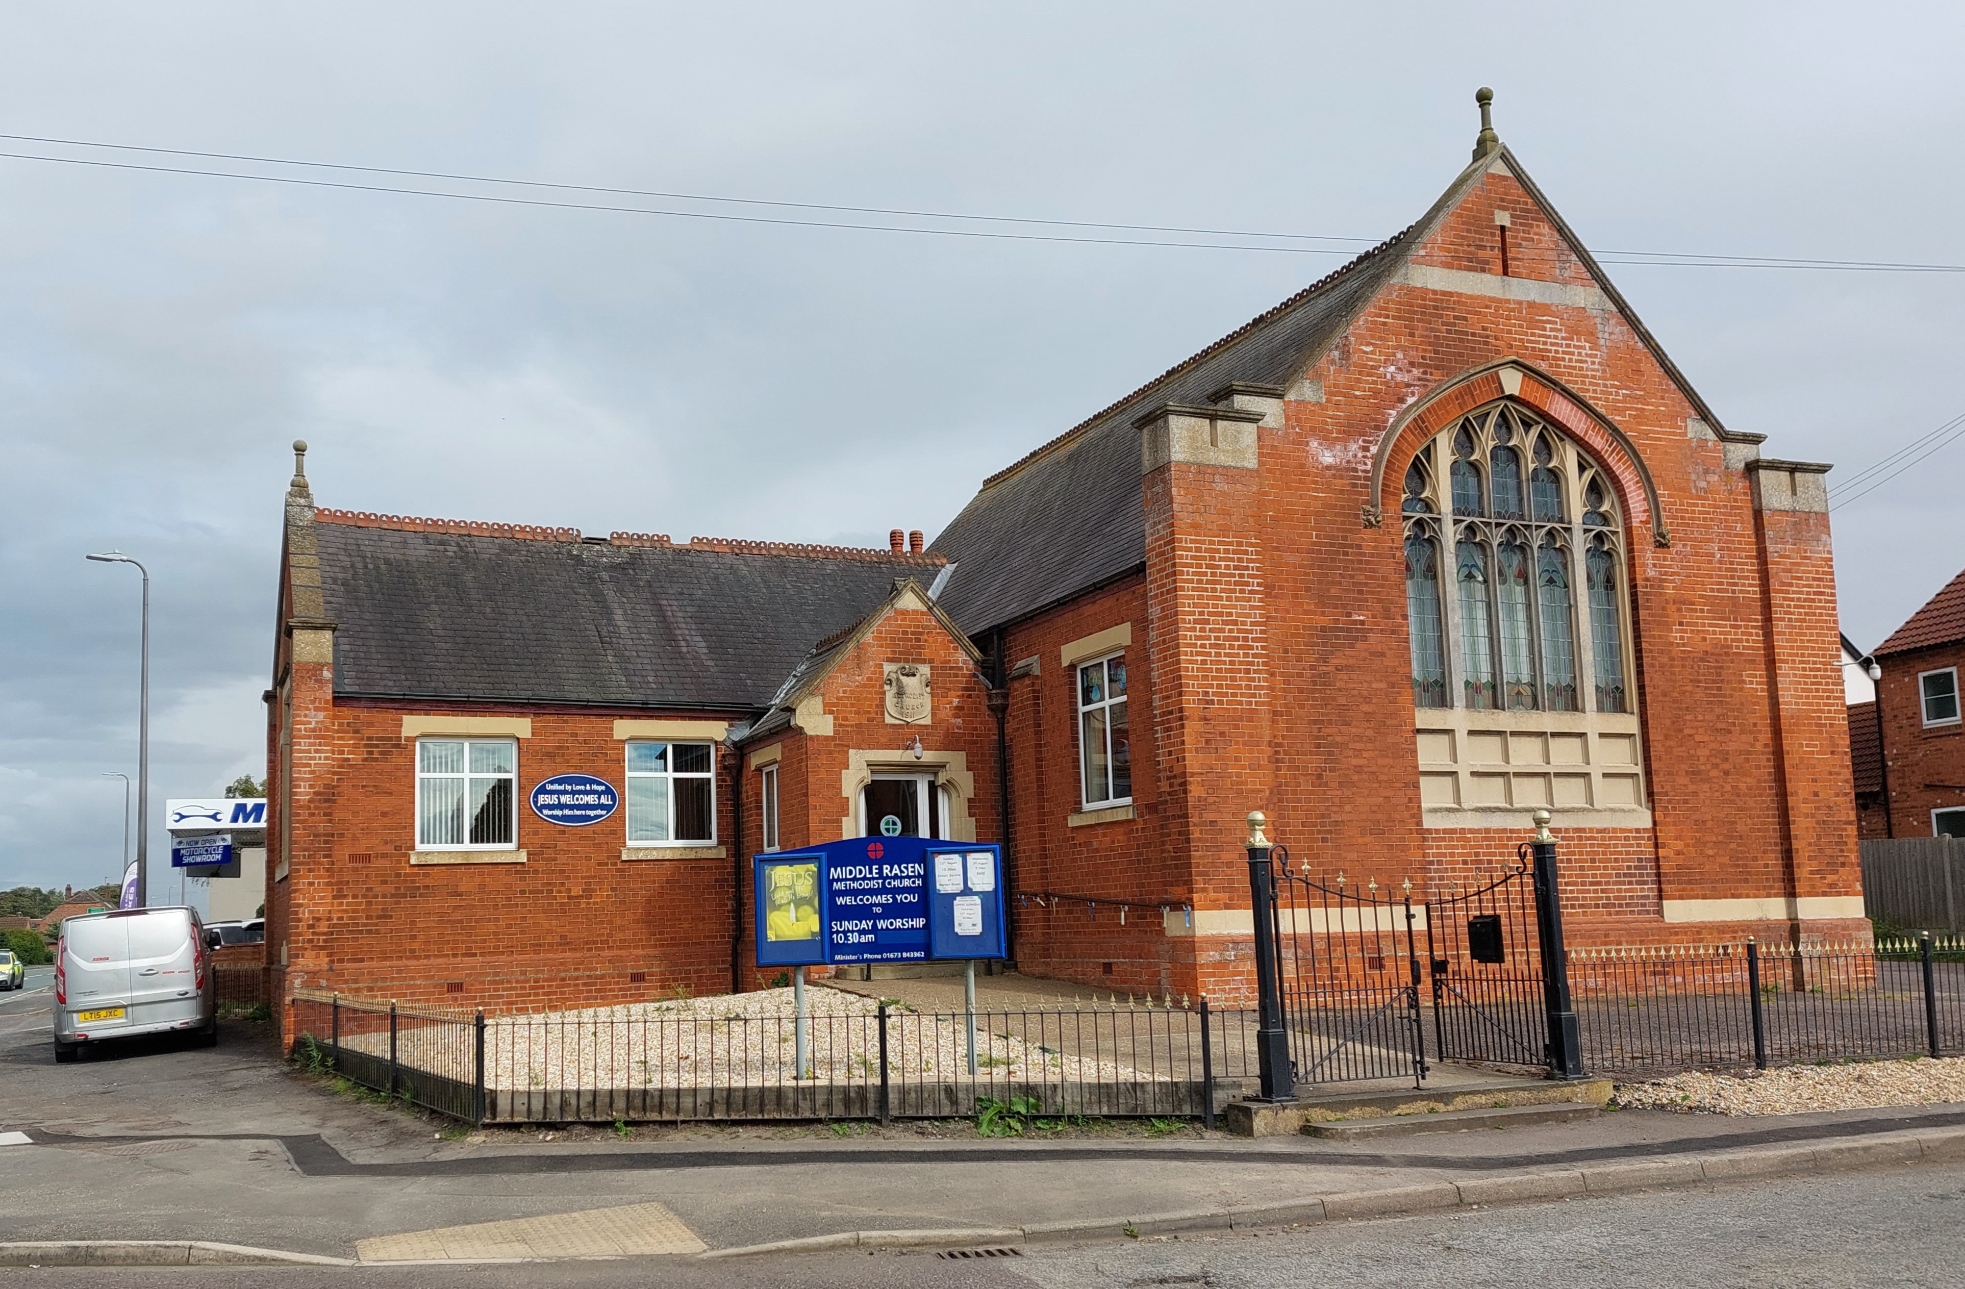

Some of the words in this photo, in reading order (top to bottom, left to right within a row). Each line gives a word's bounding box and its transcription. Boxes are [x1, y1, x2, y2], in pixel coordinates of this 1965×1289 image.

[592, 784, 606, 792] Hope
[538, 794, 558, 807] JESUS
[560, 794, 599, 804] WELCOMES
[600, 794, 613, 804] ALL
[229, 803, 267, 823] M
[542, 809, 562, 817] Worship
[180, 846, 224, 856] MOTORCYCLE
[182, 854, 222, 864] SHOWROOM
[830, 865, 879, 880] MIDDLE
[883, 863, 924, 876] RASEN
[770, 871, 813, 892] JESUS
[832, 880, 882, 890] METHODIST
[886, 878, 922, 888] CHURCH
[836, 894, 892, 905] WELCOMES
[896, 894, 918, 903] YOU
[832, 920, 874, 932] SUNDAY
[876, 918, 926, 929] WORSHIP
[84, 1012, 101, 1020] LT15
[104, 1010, 118, 1018] JXC
